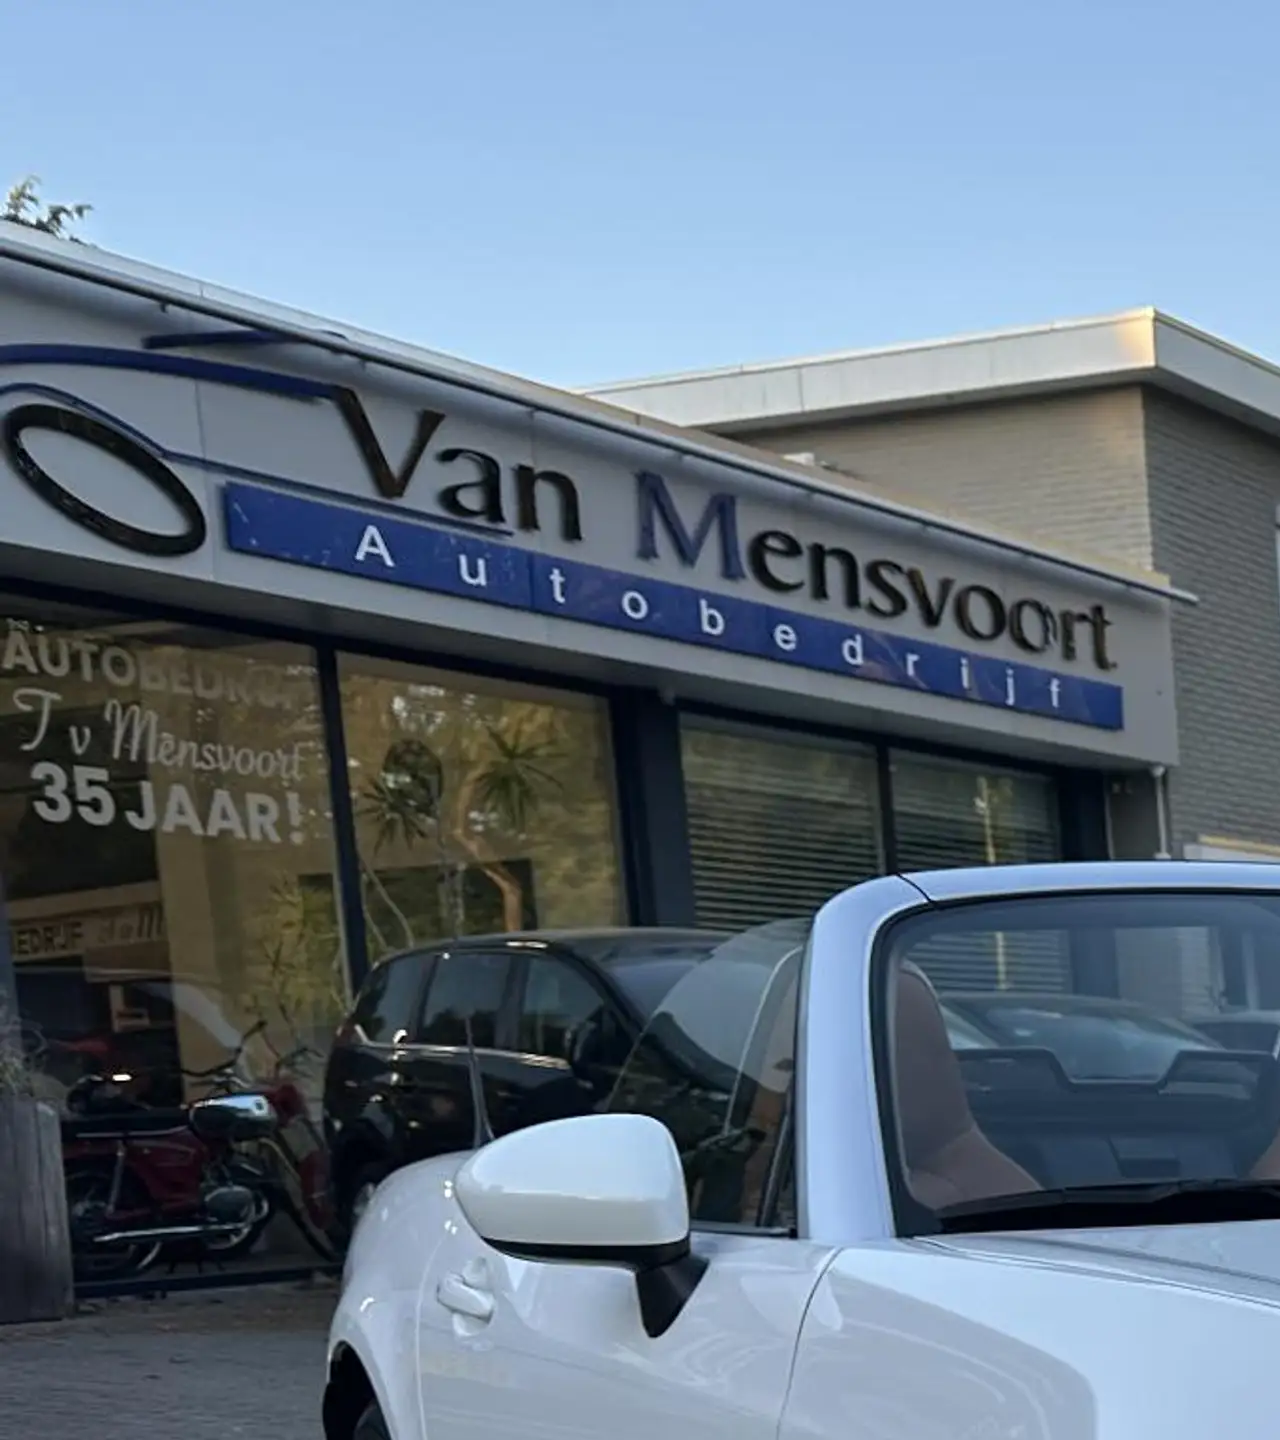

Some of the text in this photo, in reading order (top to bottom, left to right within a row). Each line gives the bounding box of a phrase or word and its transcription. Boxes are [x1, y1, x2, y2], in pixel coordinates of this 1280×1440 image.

[335, 385, 1118, 671] Van Mensvoort
[354, 524, 1062, 708] Autobedrijf
[31, 761, 304, 845] 35 JAAR!
[104, 699, 305, 782] Mensvoort
